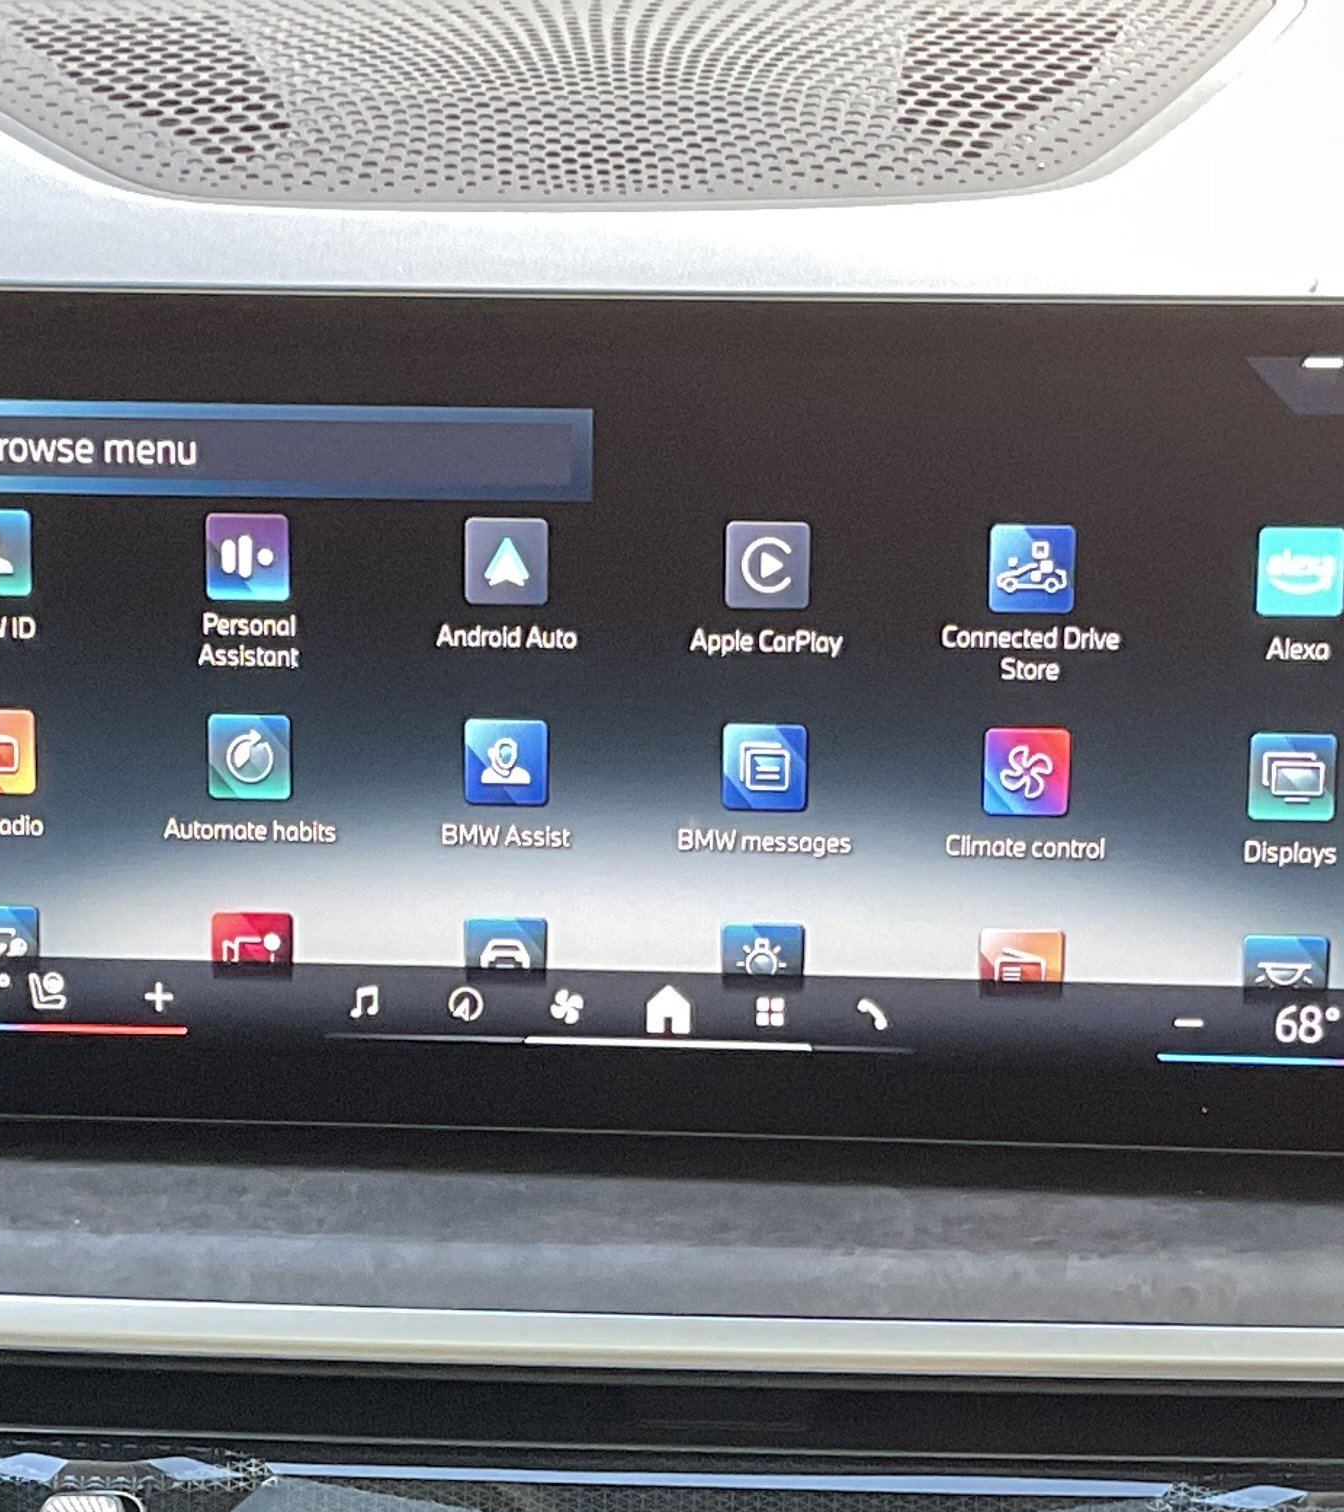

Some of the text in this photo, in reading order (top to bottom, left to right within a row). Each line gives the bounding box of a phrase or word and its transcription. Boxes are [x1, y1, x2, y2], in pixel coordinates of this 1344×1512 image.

[104, 439, 197, 466] menu
[12, 616, 36, 640] ID
[203, 612, 296, 637] Personal
[436, 624, 578, 650] Android Auto
[689, 628, 844, 658] Apple CarPlay
[941, 625, 1121, 651] Connected Drive
[1265, 636, 1331, 661] Alexa
[198, 643, 300, 669] Assistant
[1000, 657, 1060, 681] Store
[163, 817, 336, 843] Automate habits
[441, 823, 571, 848] BMW Assist
[677, 828, 852, 858] BMW messages
[945, 834, 1106, 860] Climate control
[1244, 840, 1337, 868] Displays
[1275, 1005, 1341, 1044] 68°
